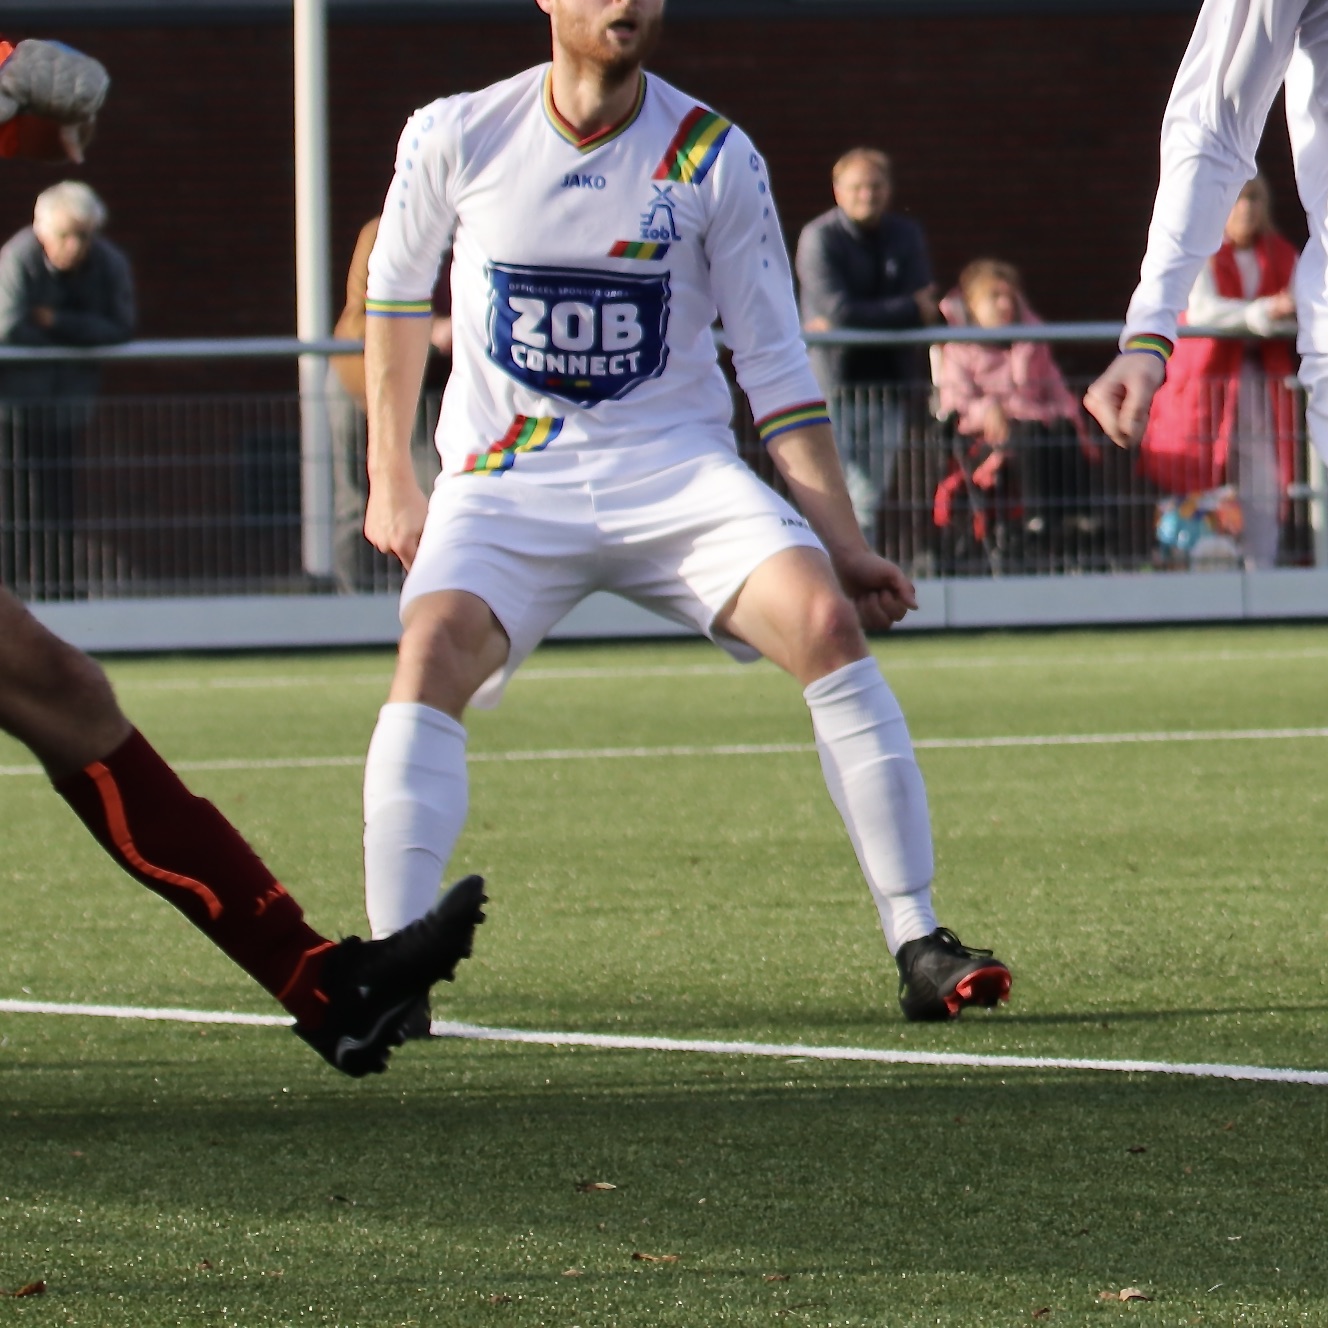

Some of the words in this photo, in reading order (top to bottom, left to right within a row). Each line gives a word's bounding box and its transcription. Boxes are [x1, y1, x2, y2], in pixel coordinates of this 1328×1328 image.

[561, 174, 606, 190] JAKO
[508, 296, 642, 352] ZOB
[510, 344, 641, 376] CONNECT
